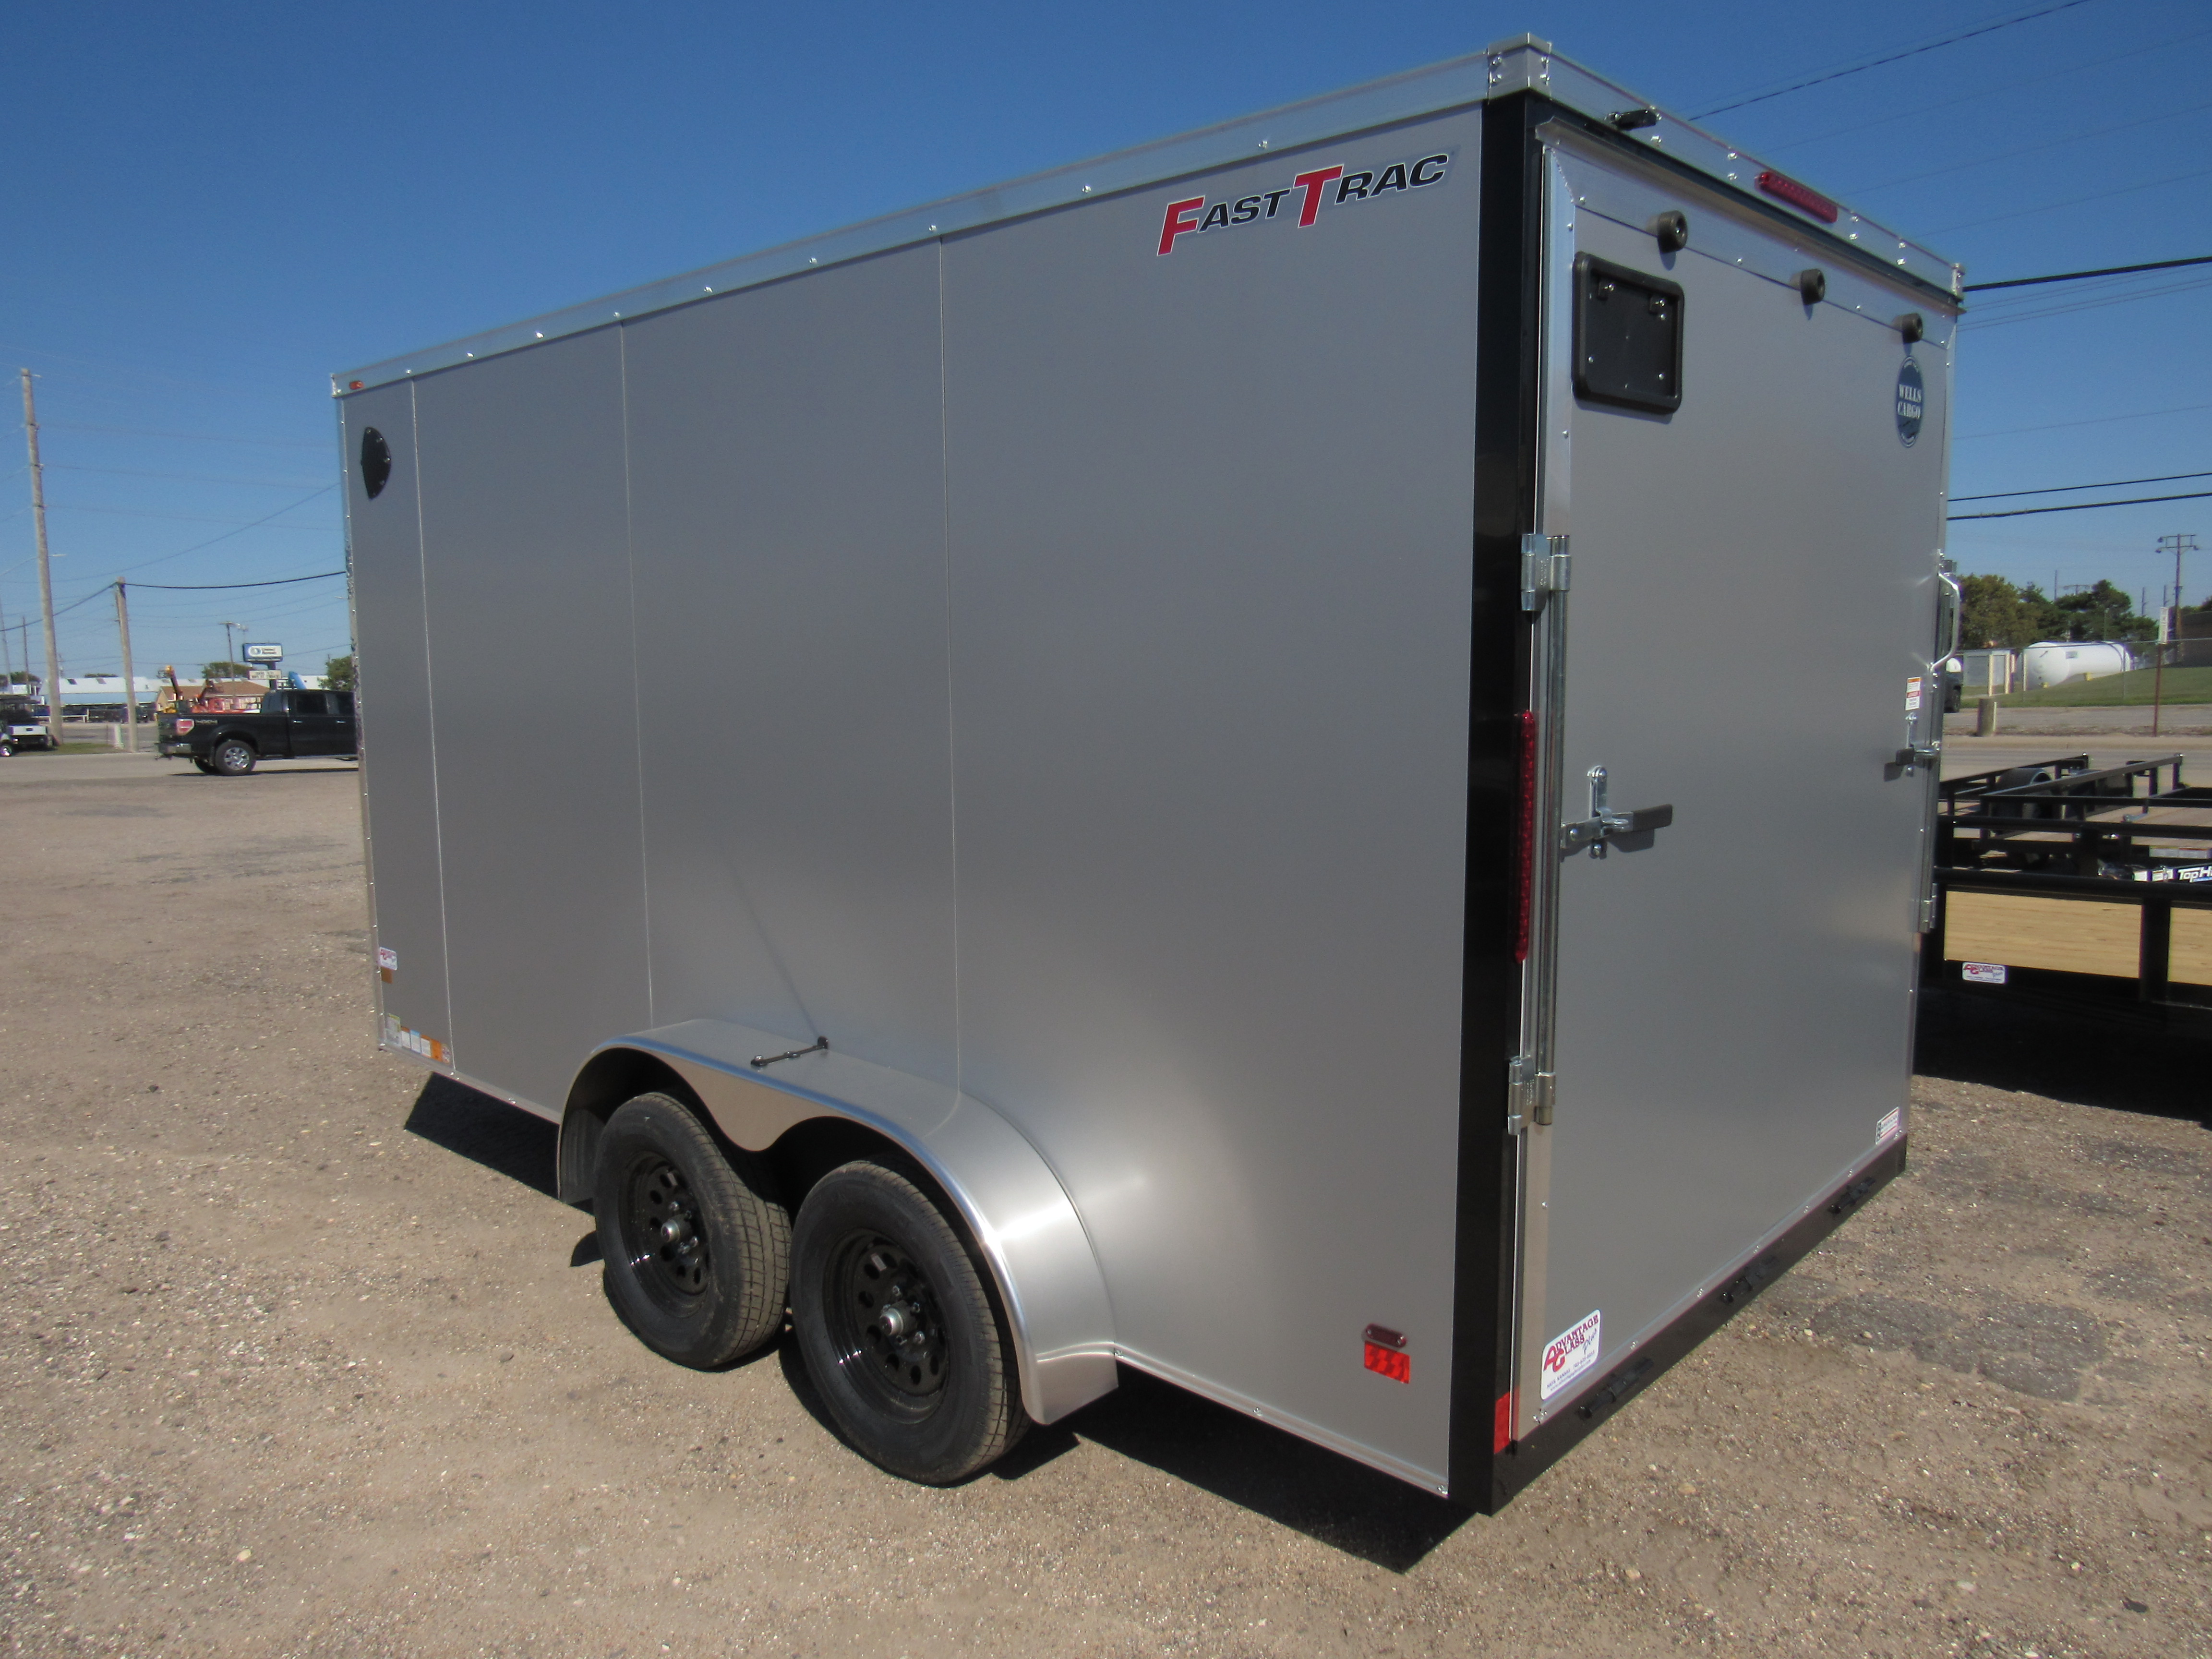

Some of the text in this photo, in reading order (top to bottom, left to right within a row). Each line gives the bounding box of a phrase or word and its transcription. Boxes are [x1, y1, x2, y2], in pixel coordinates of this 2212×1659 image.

[1157, 153, 1448, 256] FAST TRAC
[1898, 401, 1921, 420] CARGO
[1899, 384, 1922, 403] WELLS
[1543, 1314, 1599, 1372] ADVANTAGE
